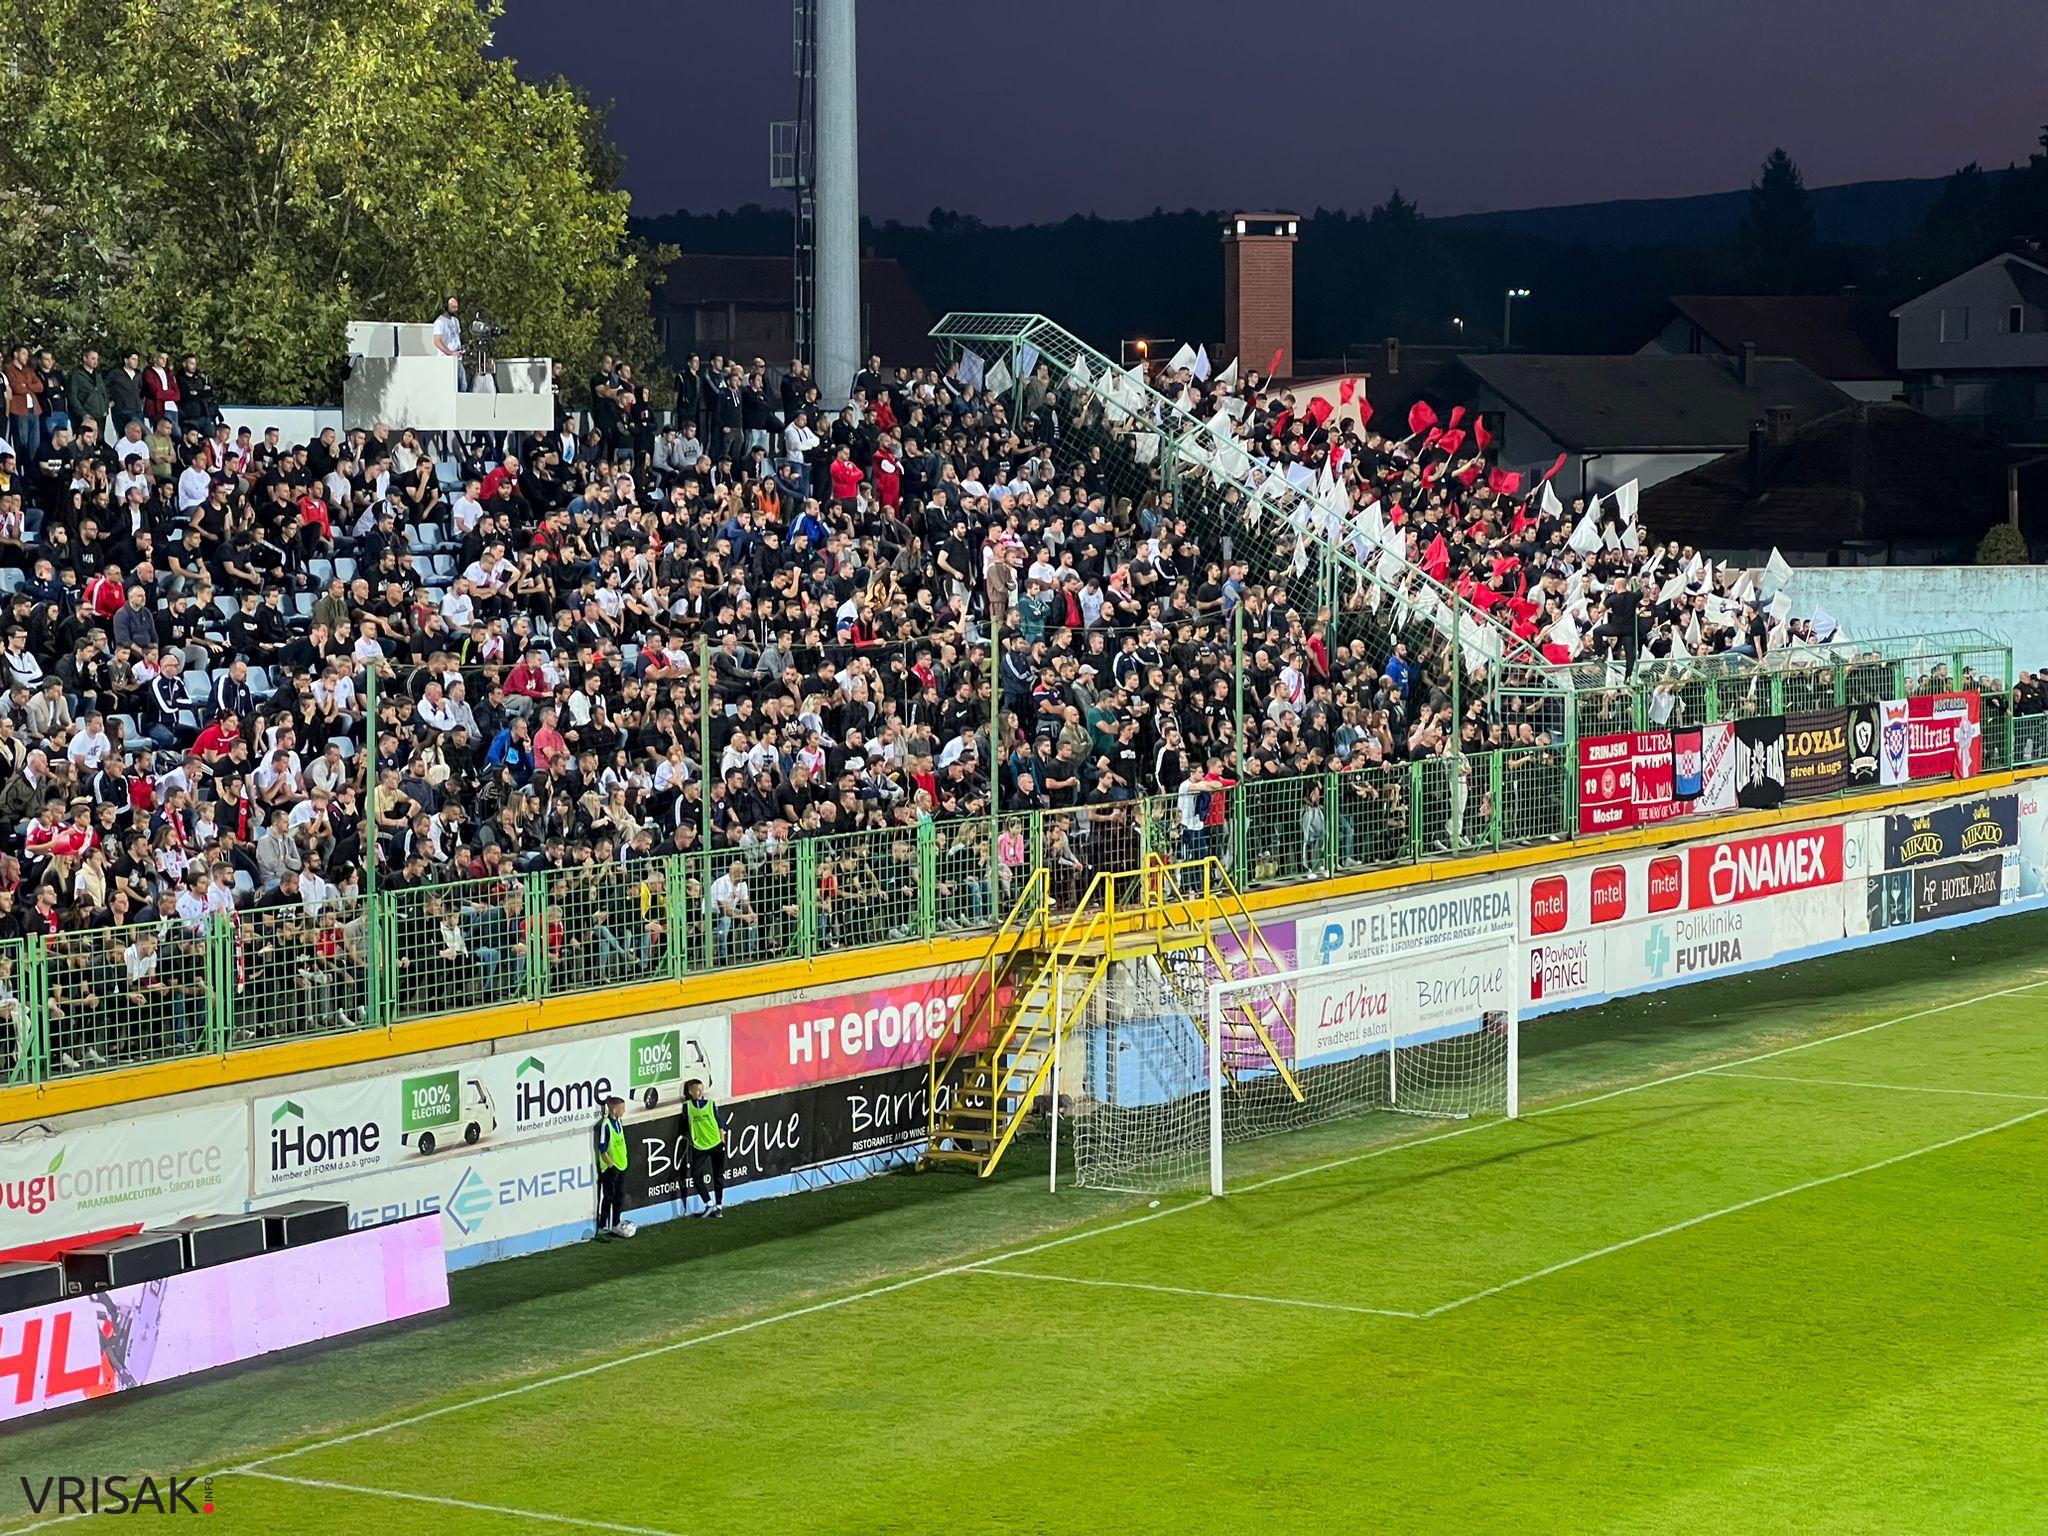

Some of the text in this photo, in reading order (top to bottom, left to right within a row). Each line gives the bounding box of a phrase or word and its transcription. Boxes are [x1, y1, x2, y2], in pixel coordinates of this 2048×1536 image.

[1588, 741, 1628, 761] ZRINJSKI
[1787, 727, 1846, 757] LOYAL
[1790, 766, 1815, 778] street
[1585, 778, 1598, 795] 19
[1593, 808, 1624, 824] Mostar
[1900, 835, 1943, 863] MIKADO
[1961, 825, 2003, 851] MIKADO
[1594, 880, 1622, 906] m:tel
[1652, 870, 1679, 896] m:tel
[1941, 870, 1997, 901] HOTEL PARK
[1534, 890, 1564, 917] m:tel
[1349, 890, 1511, 948] JP ELEKTROPRIVREDA
[1676, 909, 1742, 942] Poliklinika
[1676, 937, 1742, 973] FUTURA
[1543, 960, 1588, 992] PANELI
[788, 1016, 835, 1065] HT
[1362, 1021, 1388, 1038] salon
[638, 1042, 672, 1066] 100%
[638, 1060, 672, 1077] ELECTRIC
[412, 1083, 451, 1108] 100%
[516, 1077, 612, 1122] iHome
[411, 1102, 452, 1121] ELECTRIC
[516, 1121, 544, 1133] Member
[852, 1134, 893, 1152] RISTORANTE
[909, 1126, 926, 1139] WINE
[271, 1121, 380, 1171] iHome
[0, 1144, 222, 1215] ugicommerce
[271, 1171, 303, 1183] Member
[304, 1168, 312, 1177] of
[359, 1155, 381, 1170] group
[648, 1177, 694, 1198] RISTORATE
[732, 1165, 748, 1178] BAR
[499, 1163, 594, 1205] EMERU
[77, 1186, 162, 1211] PARAFARMACEUTIKA
